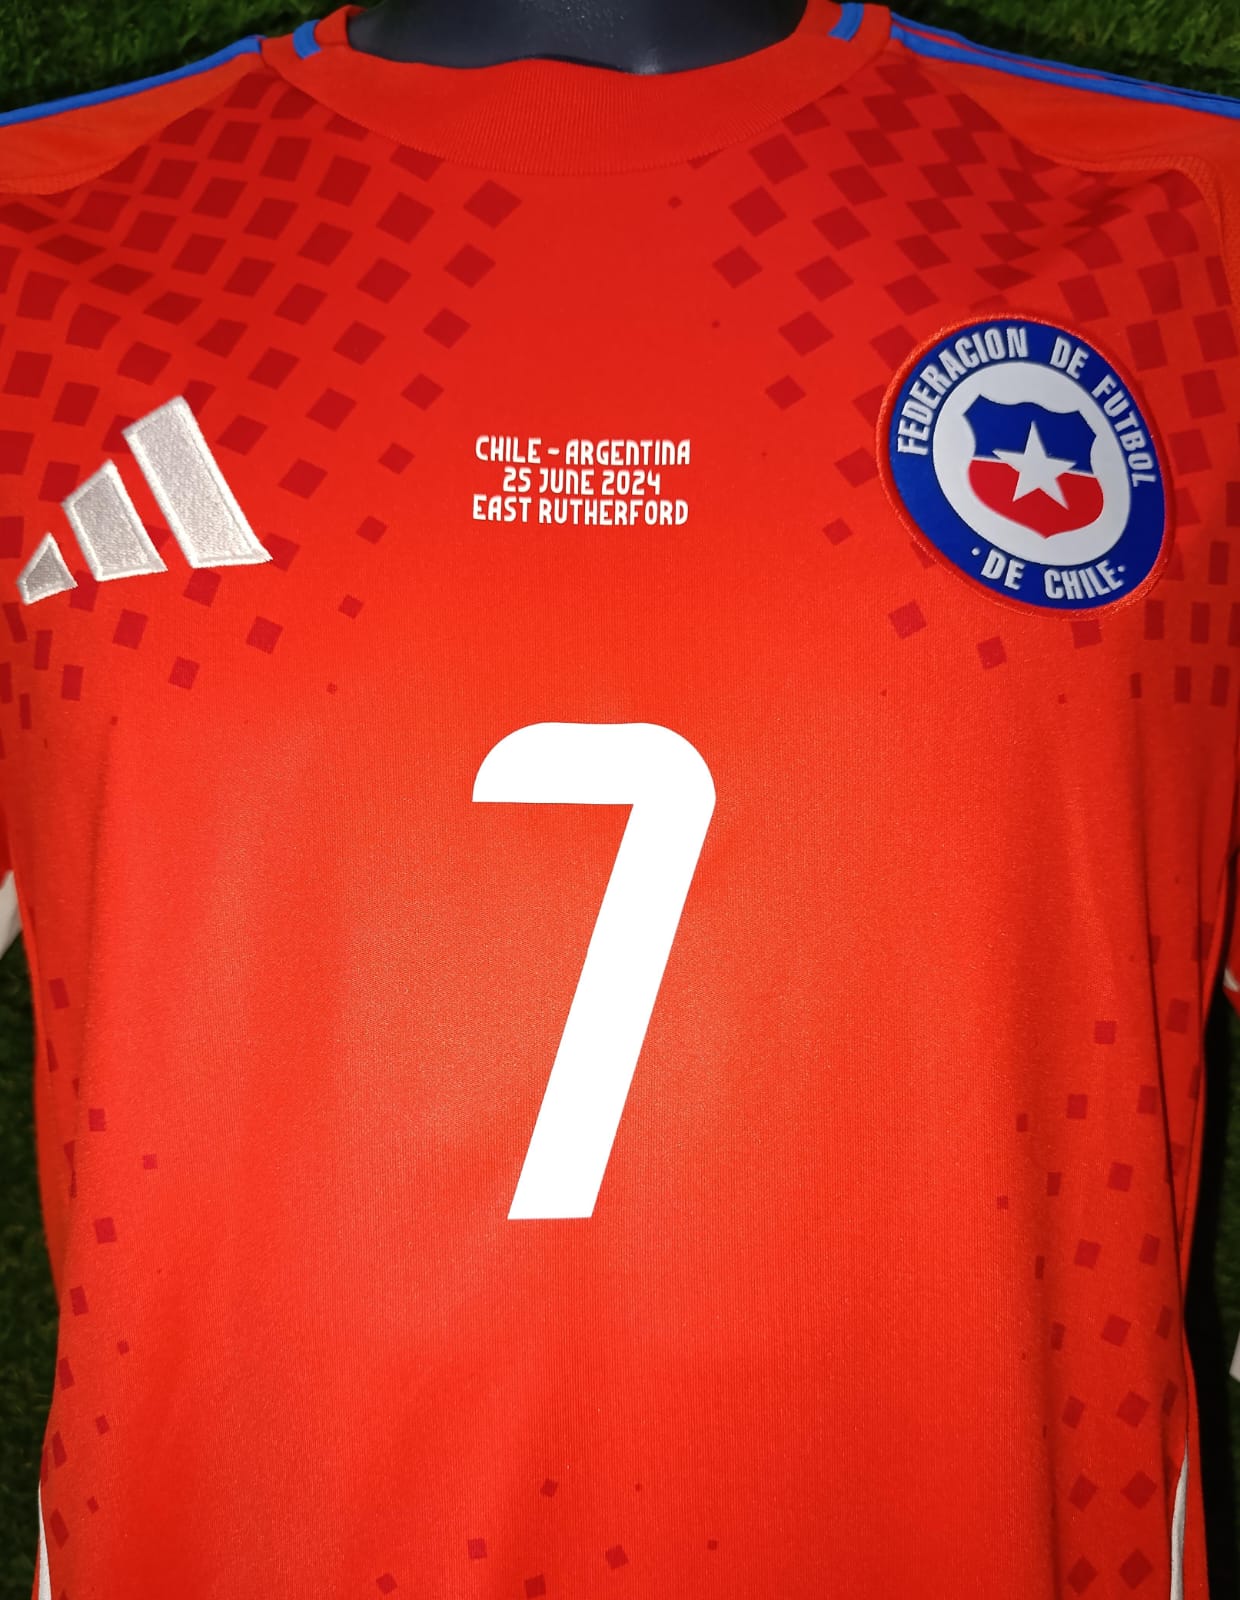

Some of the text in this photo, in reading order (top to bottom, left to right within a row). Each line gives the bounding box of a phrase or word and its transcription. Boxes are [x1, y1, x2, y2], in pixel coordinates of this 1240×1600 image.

[897, 326, 1156, 487] FEDERACION DE FUTBOL
[475, 435, 691, 466] CHILE - ARGENTINA
[502, 466, 661, 496] 25 JUNE 2024
[472, 494, 689, 526] EAST RUTHERFORD
[981, 549, 1126, 600] DE CHILE
[472, 722, 717, 1221] 7
